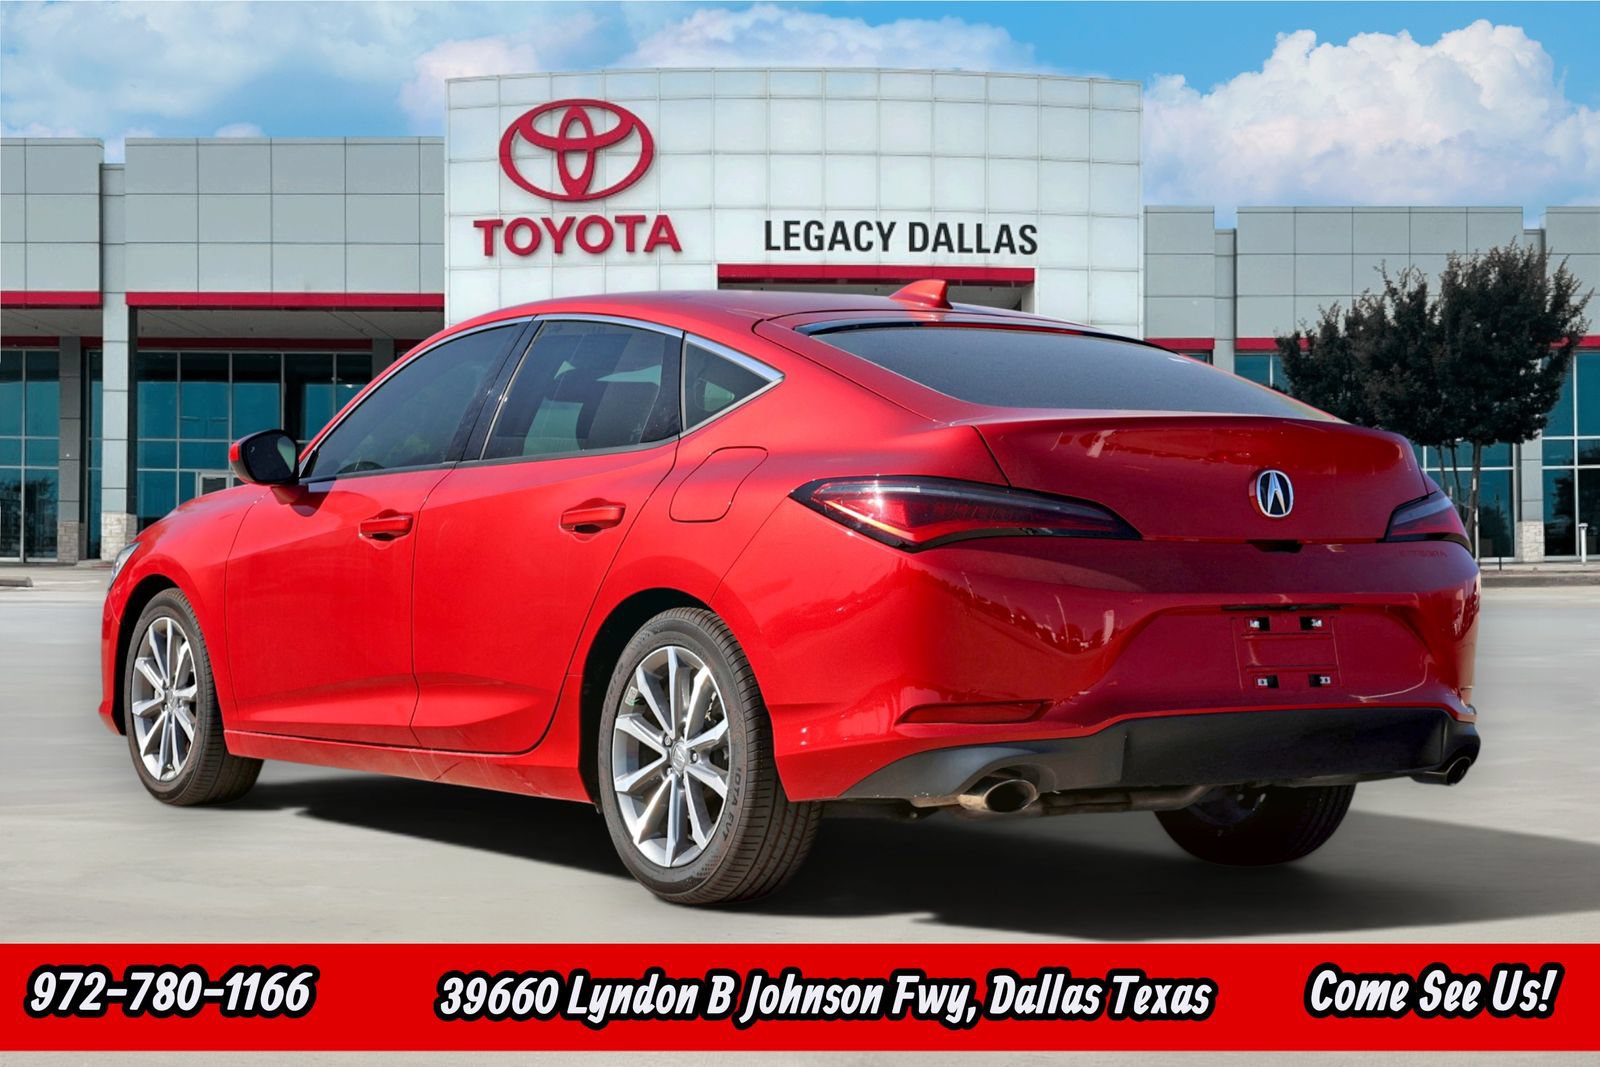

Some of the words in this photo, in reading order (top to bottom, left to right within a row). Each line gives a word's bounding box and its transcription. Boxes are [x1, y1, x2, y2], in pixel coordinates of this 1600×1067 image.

[473, 214, 682, 257] TOYOTA
[765, 220, 897, 252] LEGACY
[908, 221, 1038, 255] DALLAS
